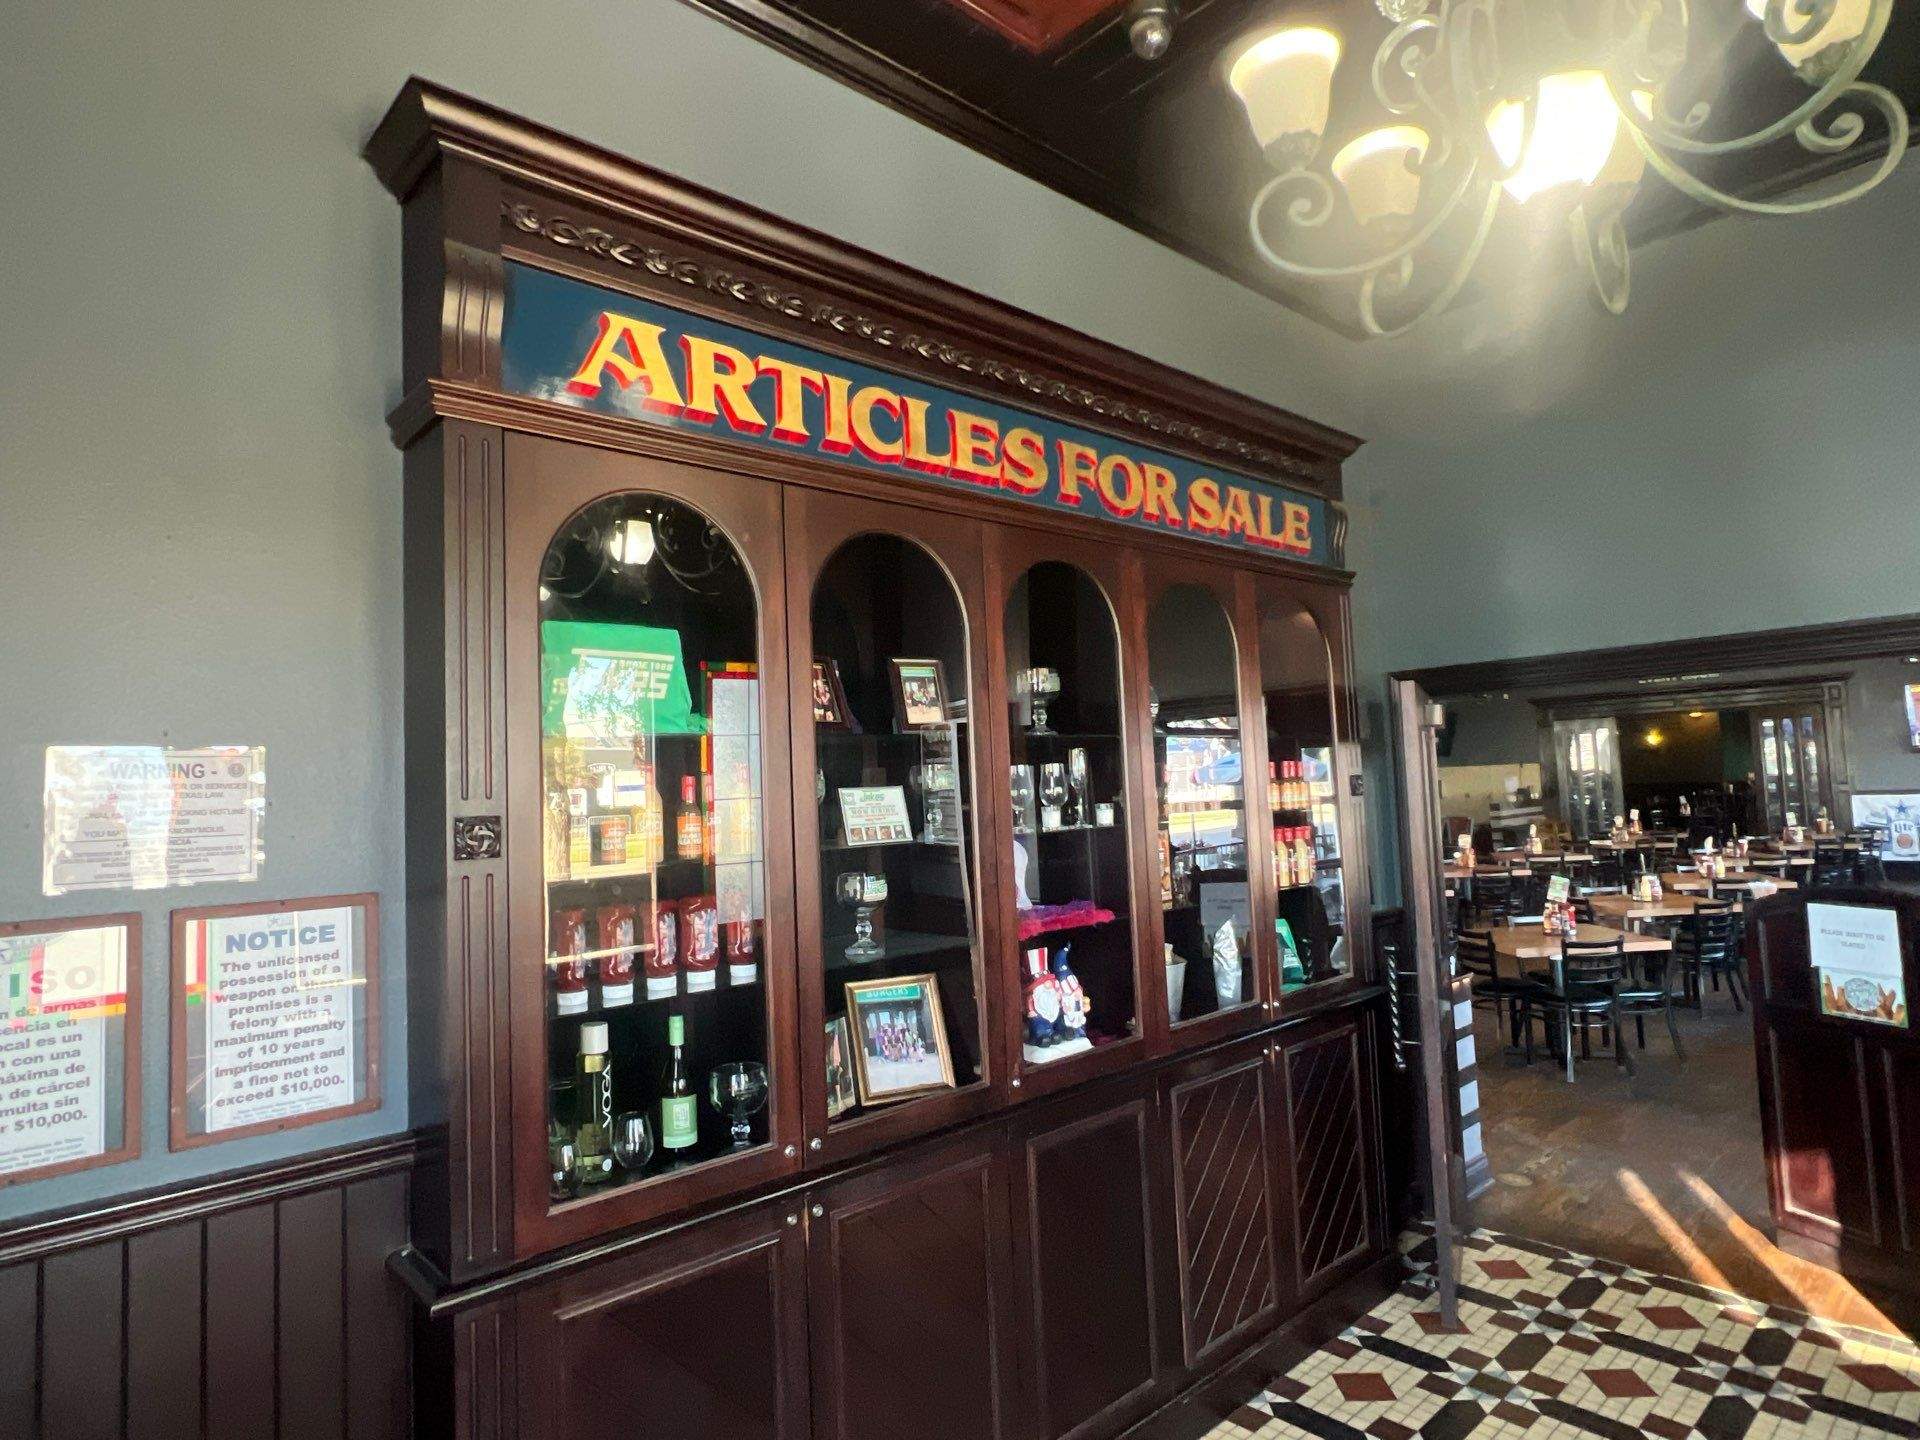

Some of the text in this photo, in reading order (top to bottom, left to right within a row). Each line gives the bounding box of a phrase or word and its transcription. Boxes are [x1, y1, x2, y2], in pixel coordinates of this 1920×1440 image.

[566, 312, 1312, 555] ARTICLES FOR SALE
[111, 763, 205, 779] WARNING
[226, 924, 336, 953] NOTICE
[220, 949, 340, 973] The unlicensed
[219, 964, 341, 990] possession of a
[215, 986, 276, 1004] weapon
[228, 994, 333, 1018] premises is a
[43, 999, 96, 1015] armas
[0, 1017, 77, 1036] encia en
[214, 1020, 345, 1048] maximum penalty
[230, 1016, 278, 1030] felony
[36, 1037, 56, 1047] es
[63, 1033, 82, 1043] un
[238, 1038, 325, 1059] of 10 years
[12, 1056, 44, 1067] con
[50, 1048, 81, 1060] una
[65, 1062, 86, 1075] de
[215, 1046, 345, 1078] imprisonment and
[10, 1076, 91, 1099] de cárcel
[233, 1065, 329, 1089] a fine not to
[216, 1075, 345, 1107] exceed $10,000.
[602, 1064, 612, 1128] VOGA
[0, 1096, 79, 1118] multa sin
[14, 1109, 88, 1132] $10,000.
